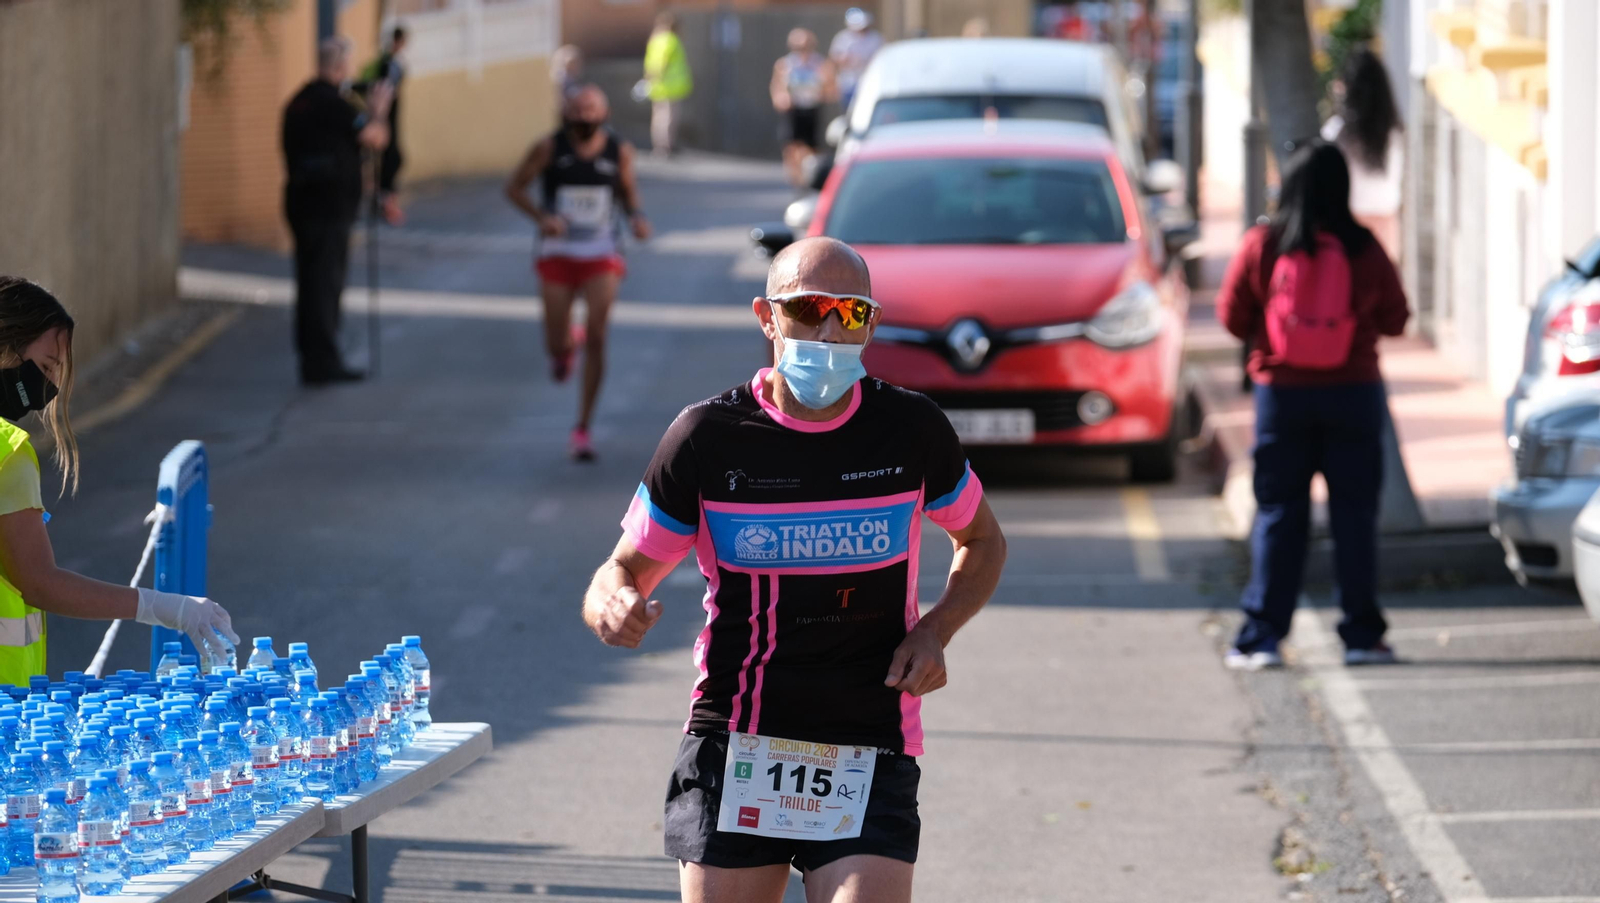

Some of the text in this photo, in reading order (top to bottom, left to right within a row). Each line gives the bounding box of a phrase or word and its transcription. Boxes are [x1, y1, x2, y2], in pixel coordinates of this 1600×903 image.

[841, 467, 893, 481] GSPORT
[779, 517, 889, 541] TRIATLÓN
[736, 550, 778, 560] INDALO
[782, 533, 891, 560] INDALO
[796, 614, 841, 625] FARMACIA
[769, 738, 812, 755] CIRCUITO
[767, 751, 837, 769] CARRERAS POPULARES
[740, 765, 747, 777] C
[766, 762, 833, 798] 115
[837, 783, 857, 801] R
[779, 795, 823, 813] TRIILDE
